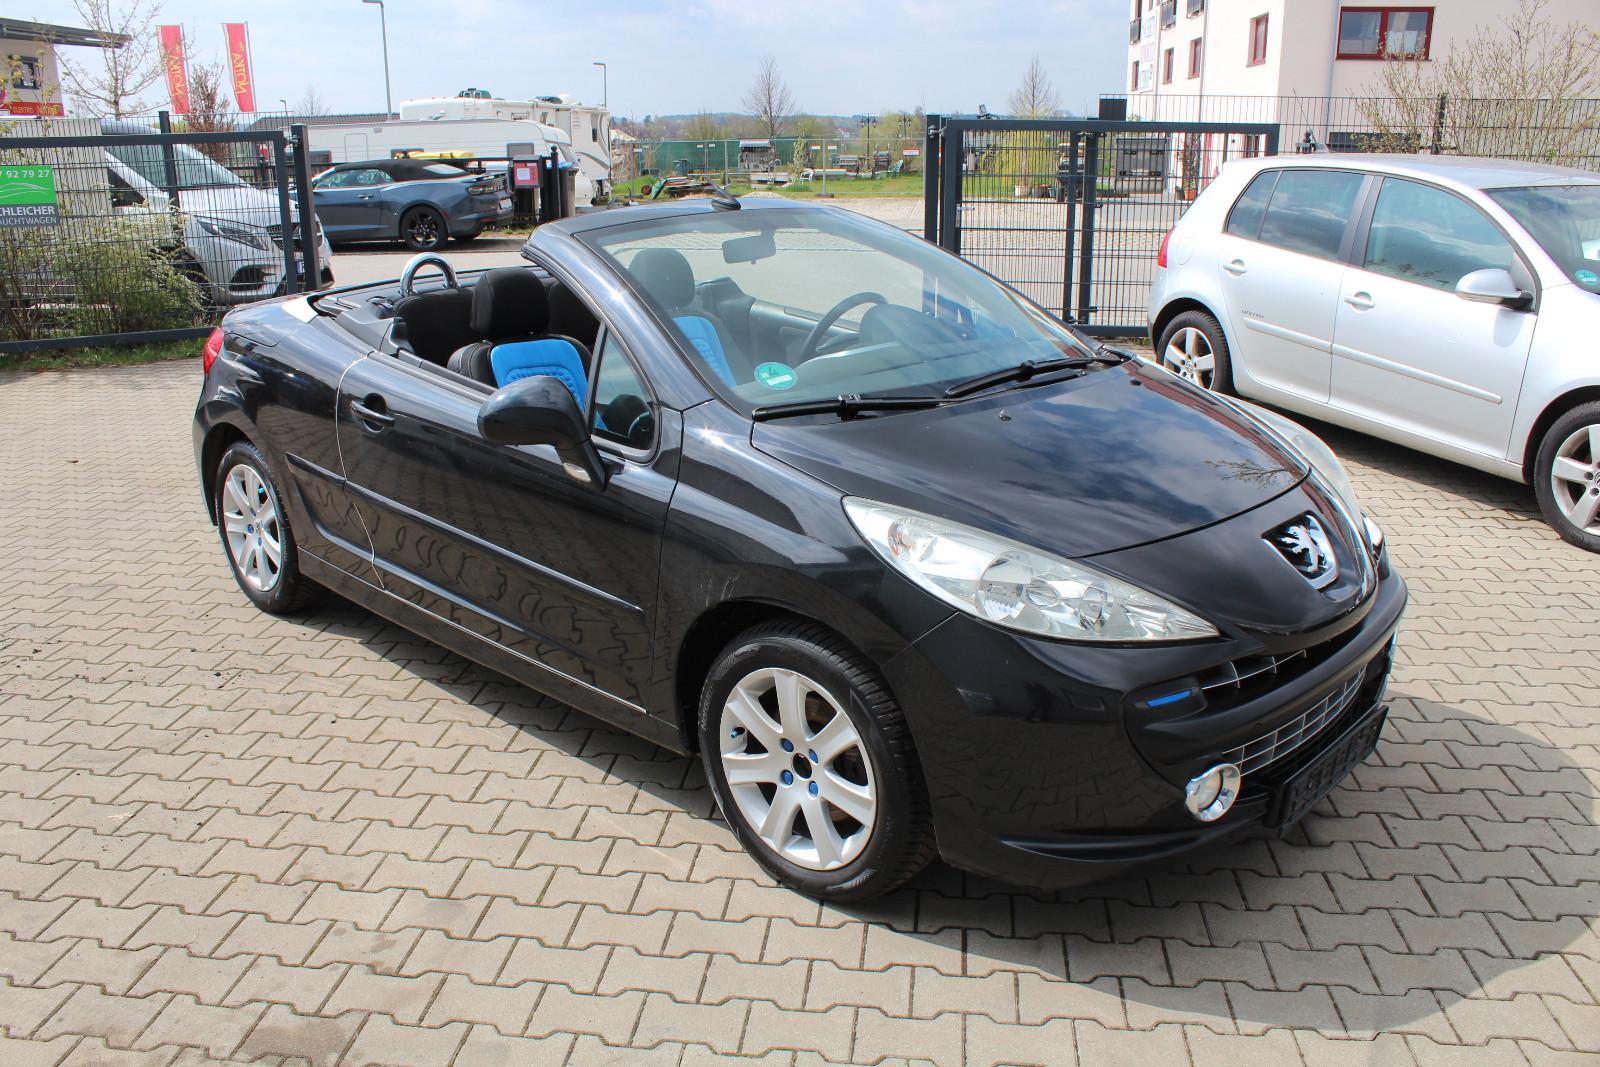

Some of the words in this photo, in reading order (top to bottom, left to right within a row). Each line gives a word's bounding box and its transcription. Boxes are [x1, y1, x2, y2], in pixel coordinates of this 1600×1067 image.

[6, 170, 18, 178] 92
[22, 170, 34, 178] 79
[38, 170, 49, 178] 27
[0, 206, 55, 217] HLEICHER
